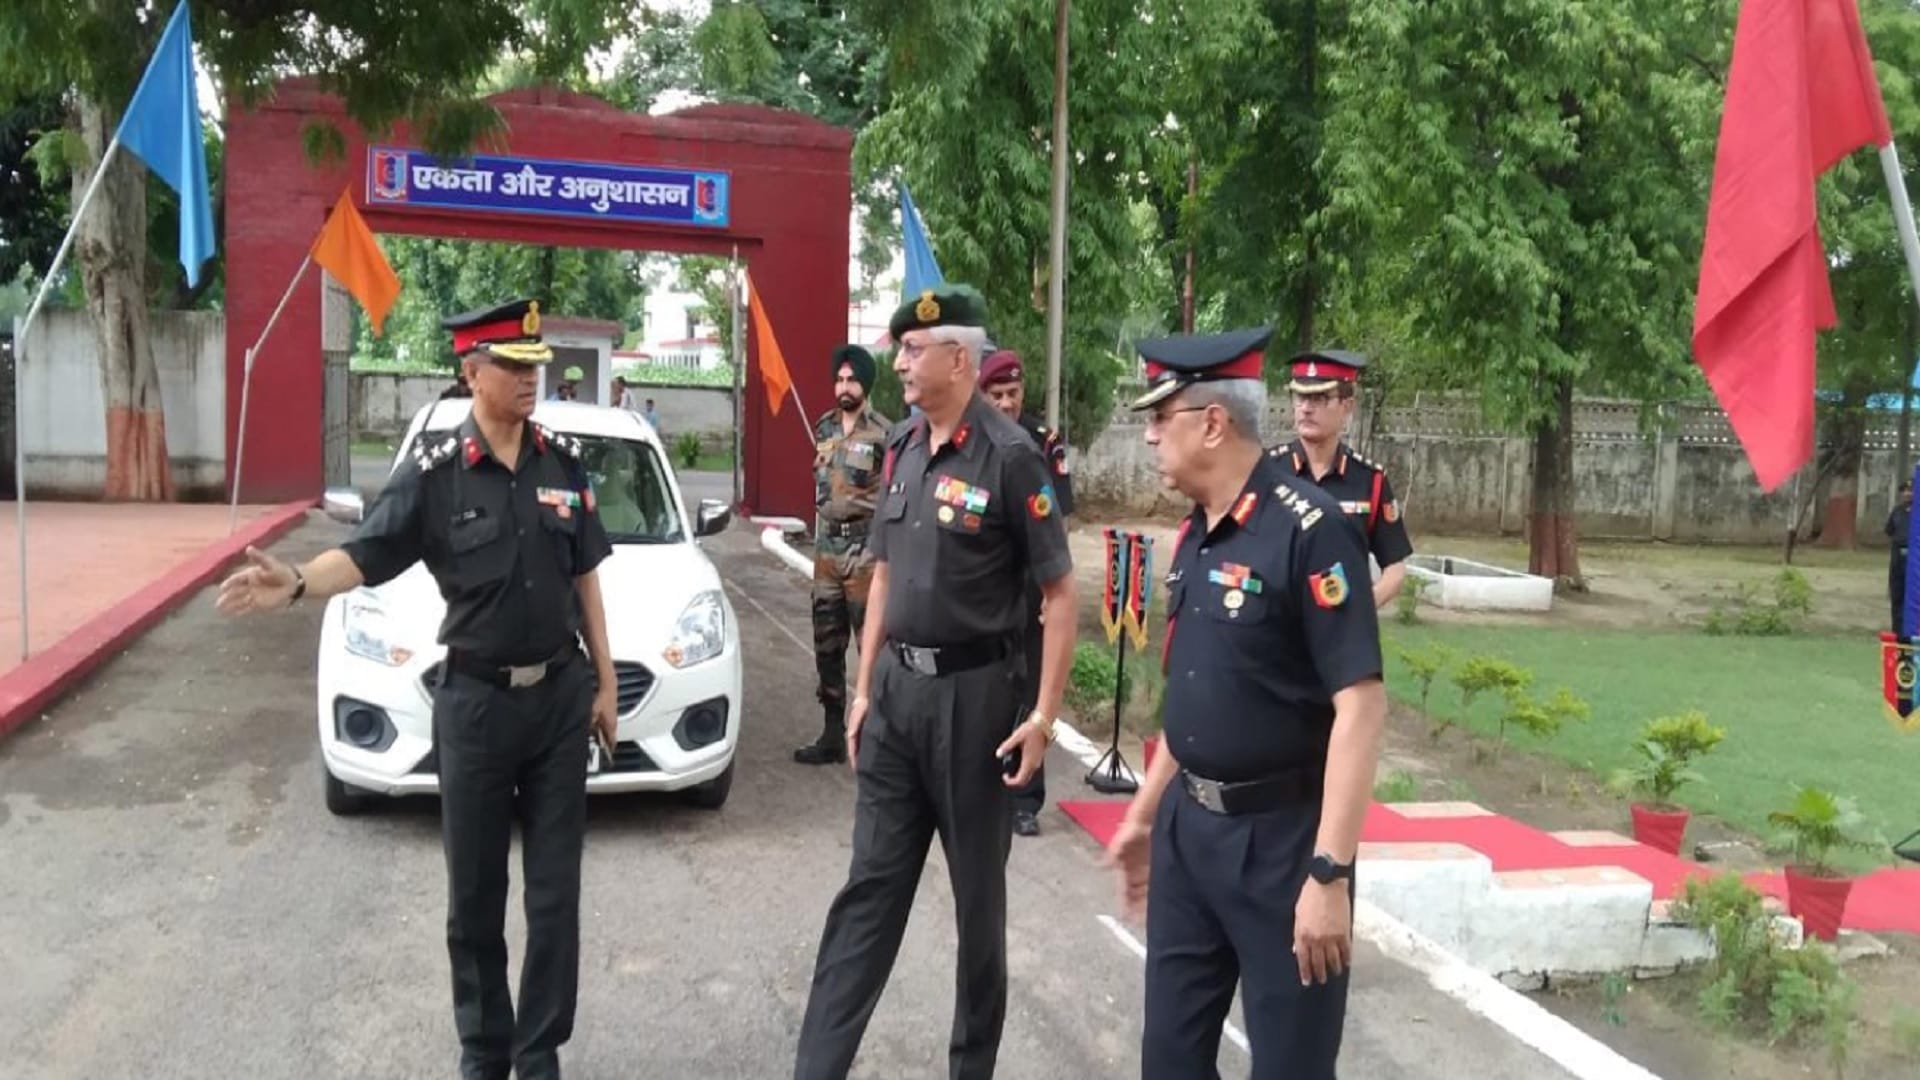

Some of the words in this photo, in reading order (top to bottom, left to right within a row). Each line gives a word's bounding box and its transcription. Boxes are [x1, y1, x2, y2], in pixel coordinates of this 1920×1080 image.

[412, 165, 493, 193] एकता
[499, 164, 555, 197] और
[558, 176, 690, 212] अनुशासन
